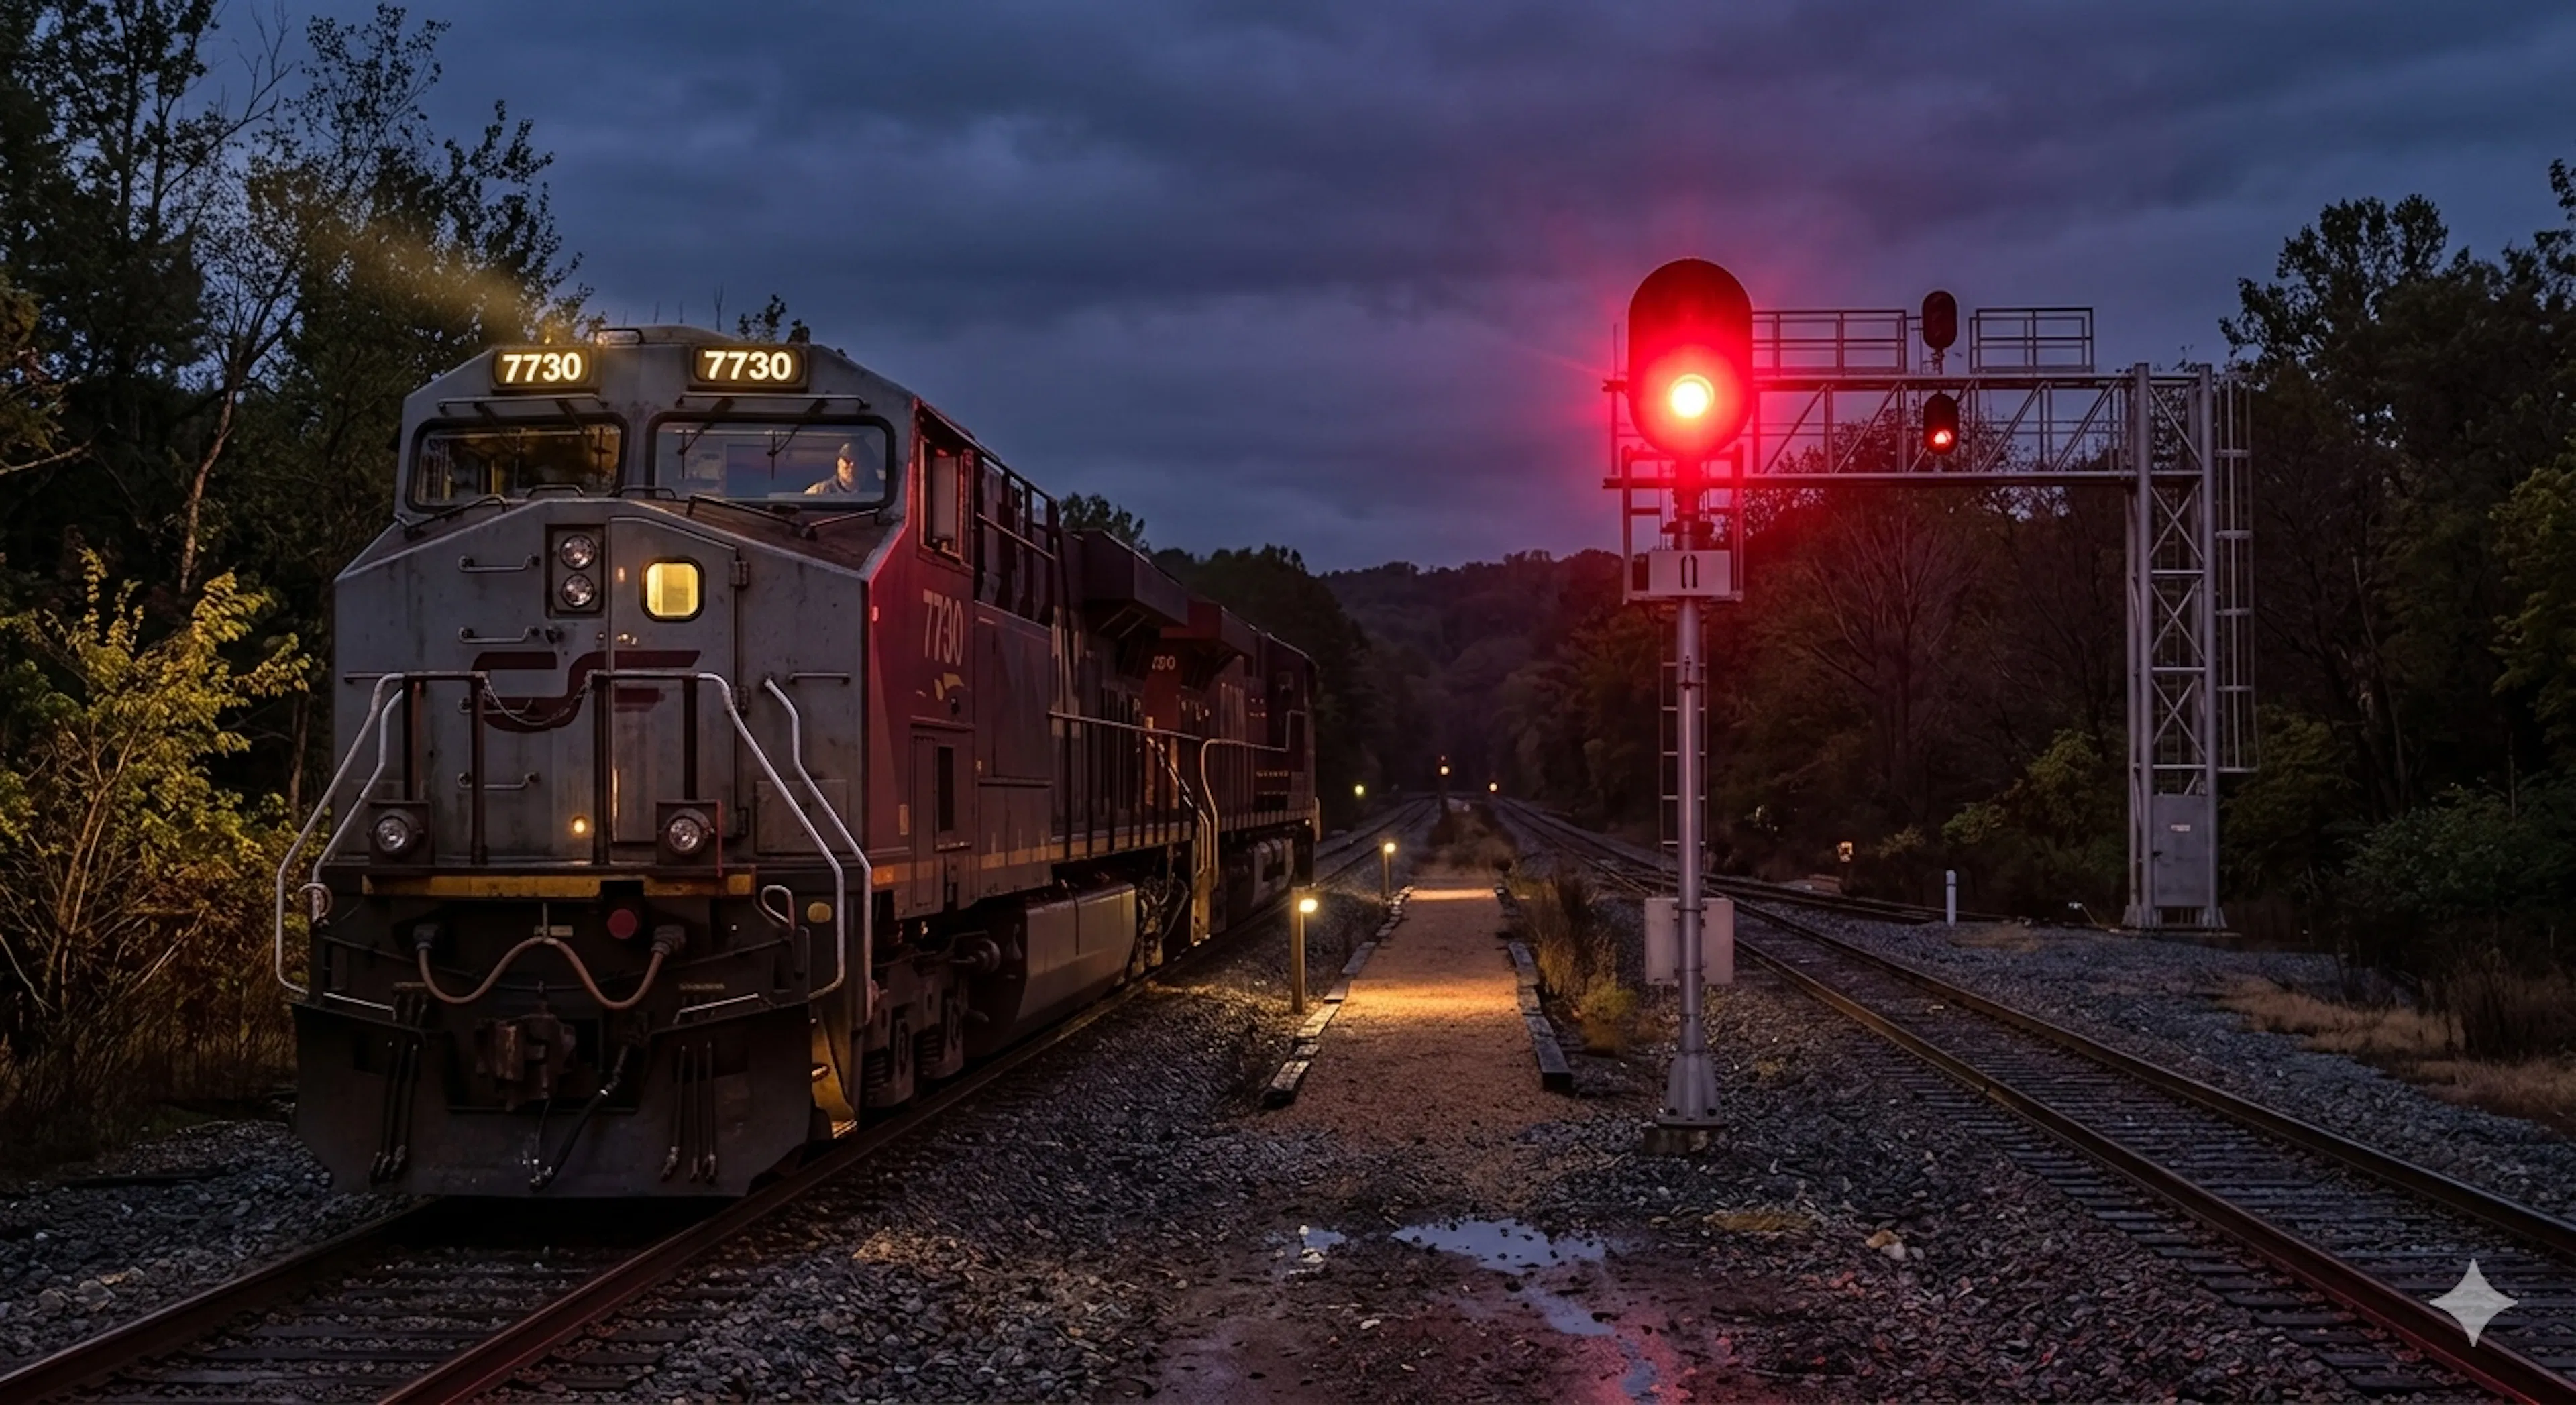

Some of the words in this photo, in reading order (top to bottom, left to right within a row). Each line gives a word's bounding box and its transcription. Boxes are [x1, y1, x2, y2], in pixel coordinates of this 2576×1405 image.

[502, 353, 582, 382] 7730
[704, 351, 792, 380] 7730
[922, 588, 964, 667] 7730
